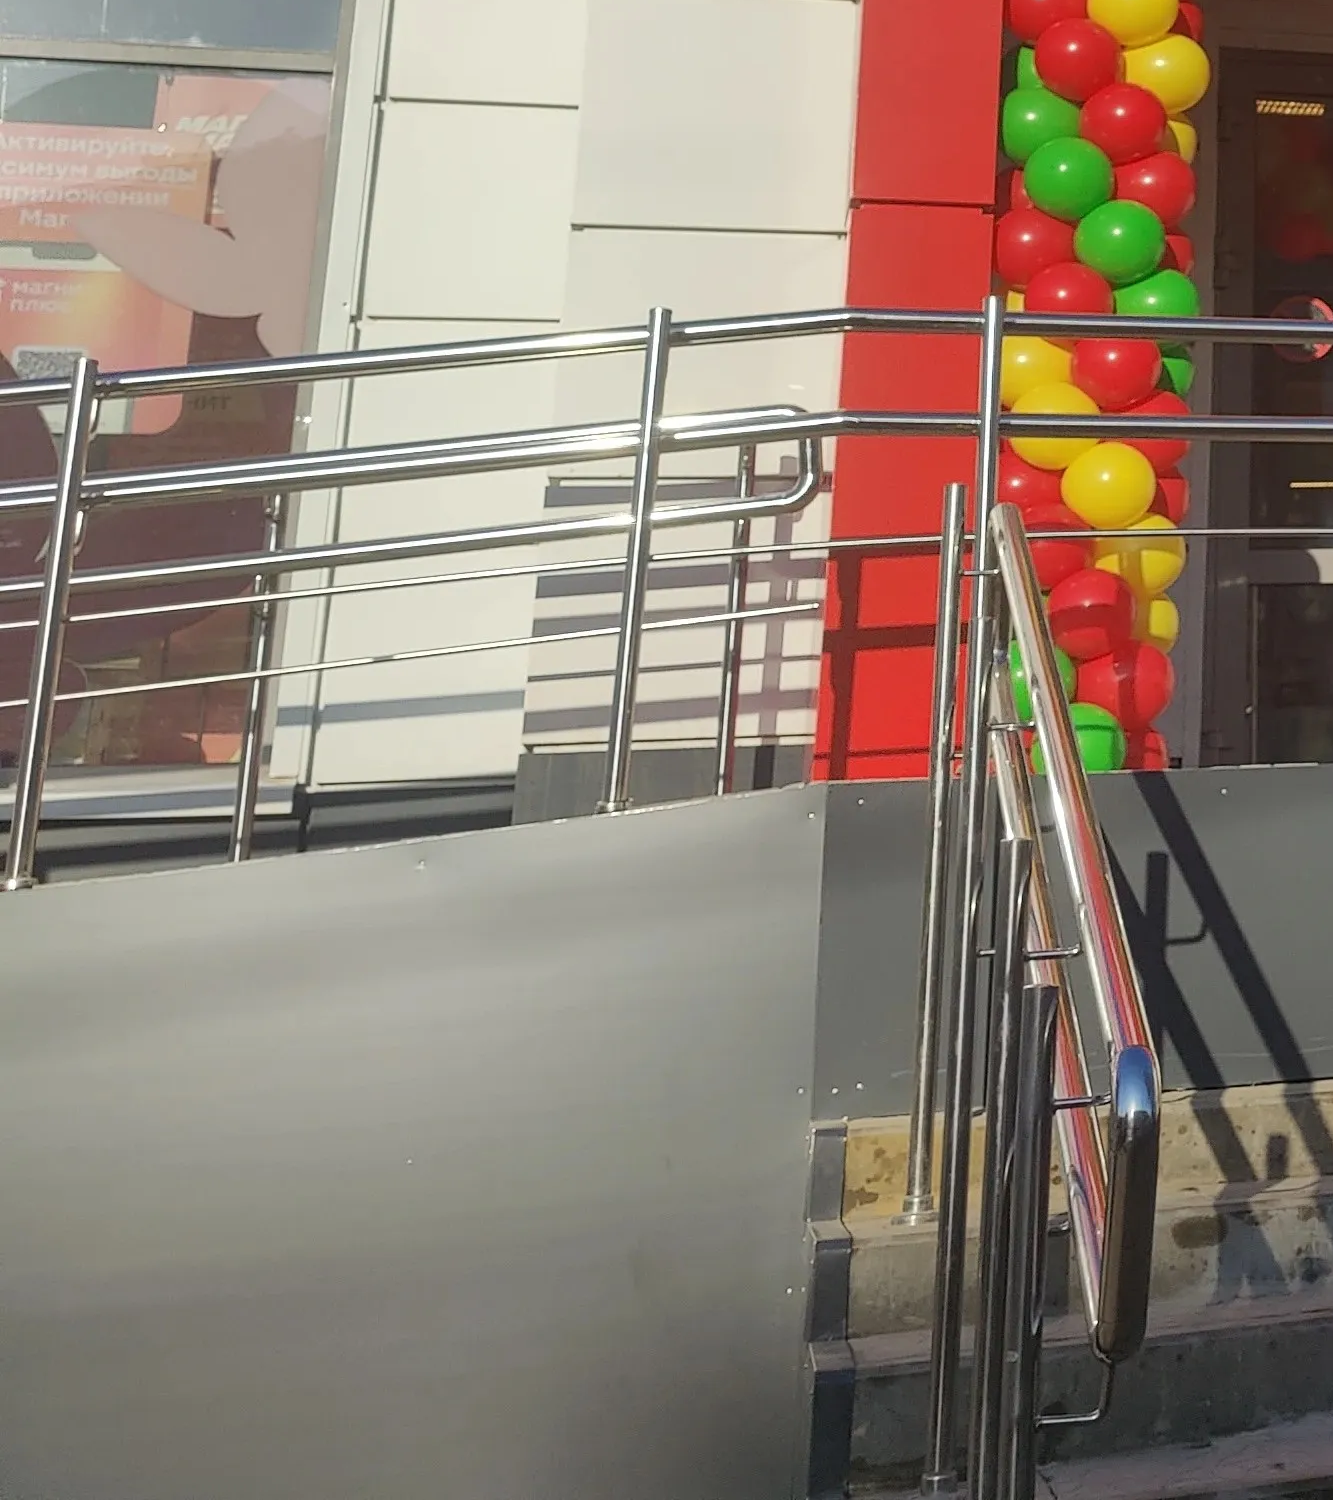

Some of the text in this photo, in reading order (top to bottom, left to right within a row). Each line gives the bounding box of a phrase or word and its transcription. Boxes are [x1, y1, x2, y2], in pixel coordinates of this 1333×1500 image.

[175, 114, 248, 132] МАГ
[0, 160, 88, 180] симум
[20, 209, 71, 228] Маг
